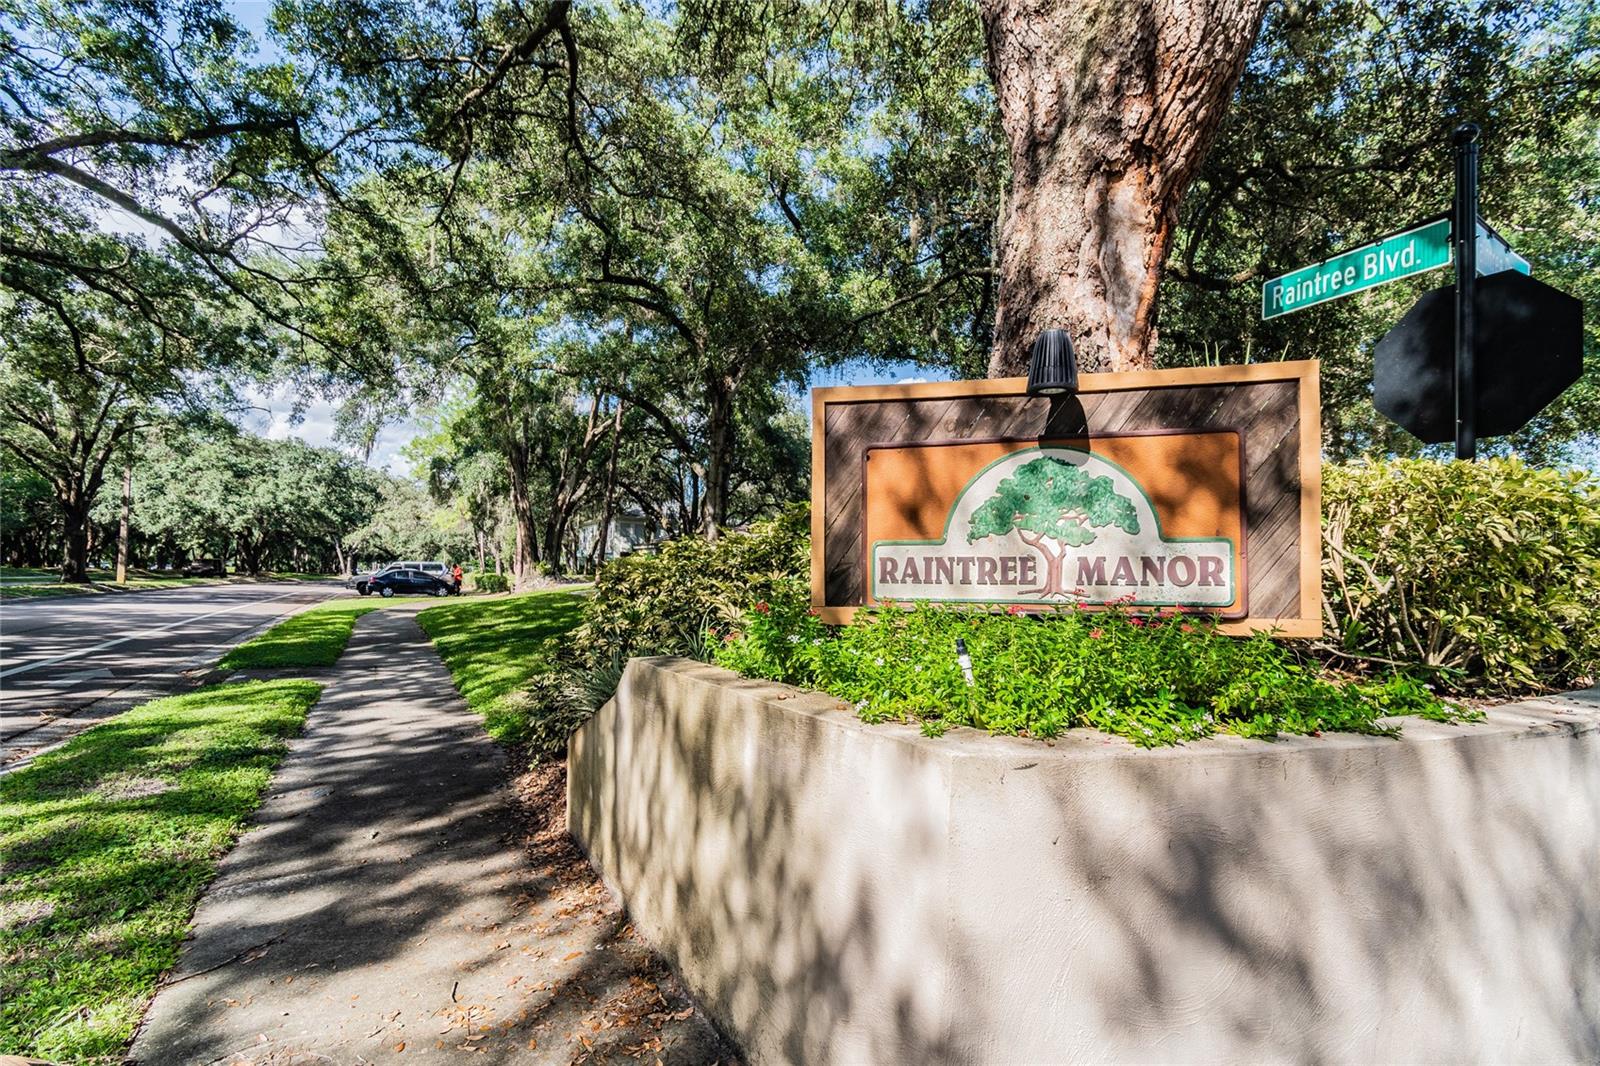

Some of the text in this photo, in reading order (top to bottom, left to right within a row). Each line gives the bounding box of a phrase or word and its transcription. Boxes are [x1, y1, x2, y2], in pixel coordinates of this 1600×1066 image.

[1272, 239, 1422, 309] Raintree Blvd.
[879, 555, 1225, 587] RAINTREE MANOR
